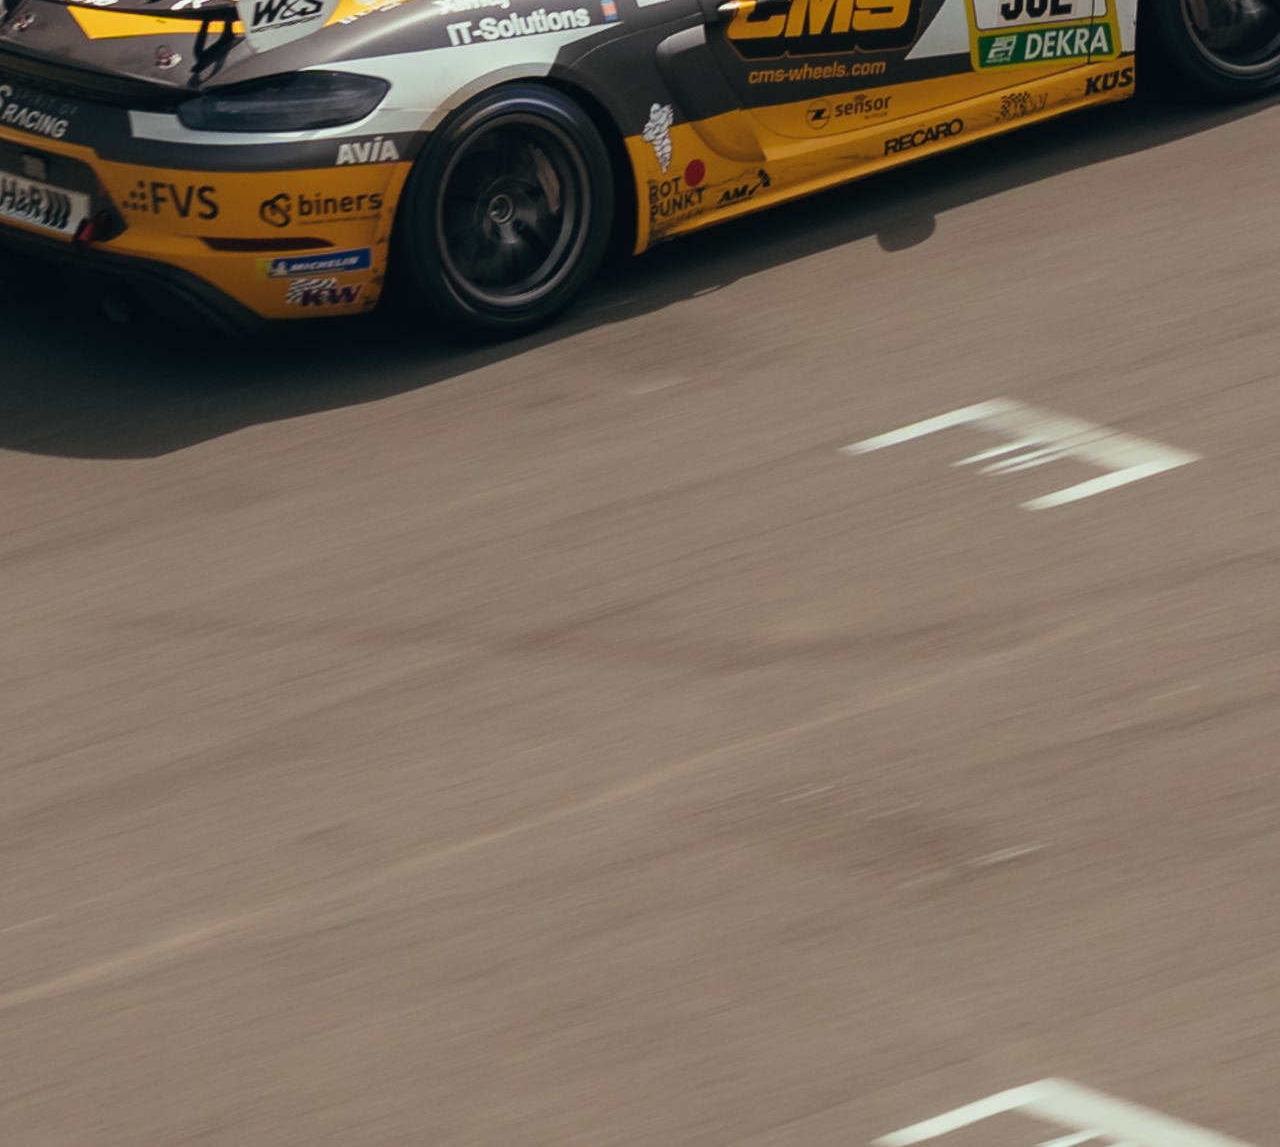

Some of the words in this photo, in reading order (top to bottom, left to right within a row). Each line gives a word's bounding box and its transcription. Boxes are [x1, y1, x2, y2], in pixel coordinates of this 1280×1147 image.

[445, 8, 591, 46] IT-Solutions
[1024, 25, 1110, 60] DEKRA
[748, 61, 886, 84] cms-wheels.com
[1, 103, 69, 138] RACING
[834, 96, 892, 118] sensor
[884, 118, 964, 156] RECARO
[149, 181, 220, 220] FVS
[298, 192, 383, 217] biners
[299, 284, 364, 308] KW
